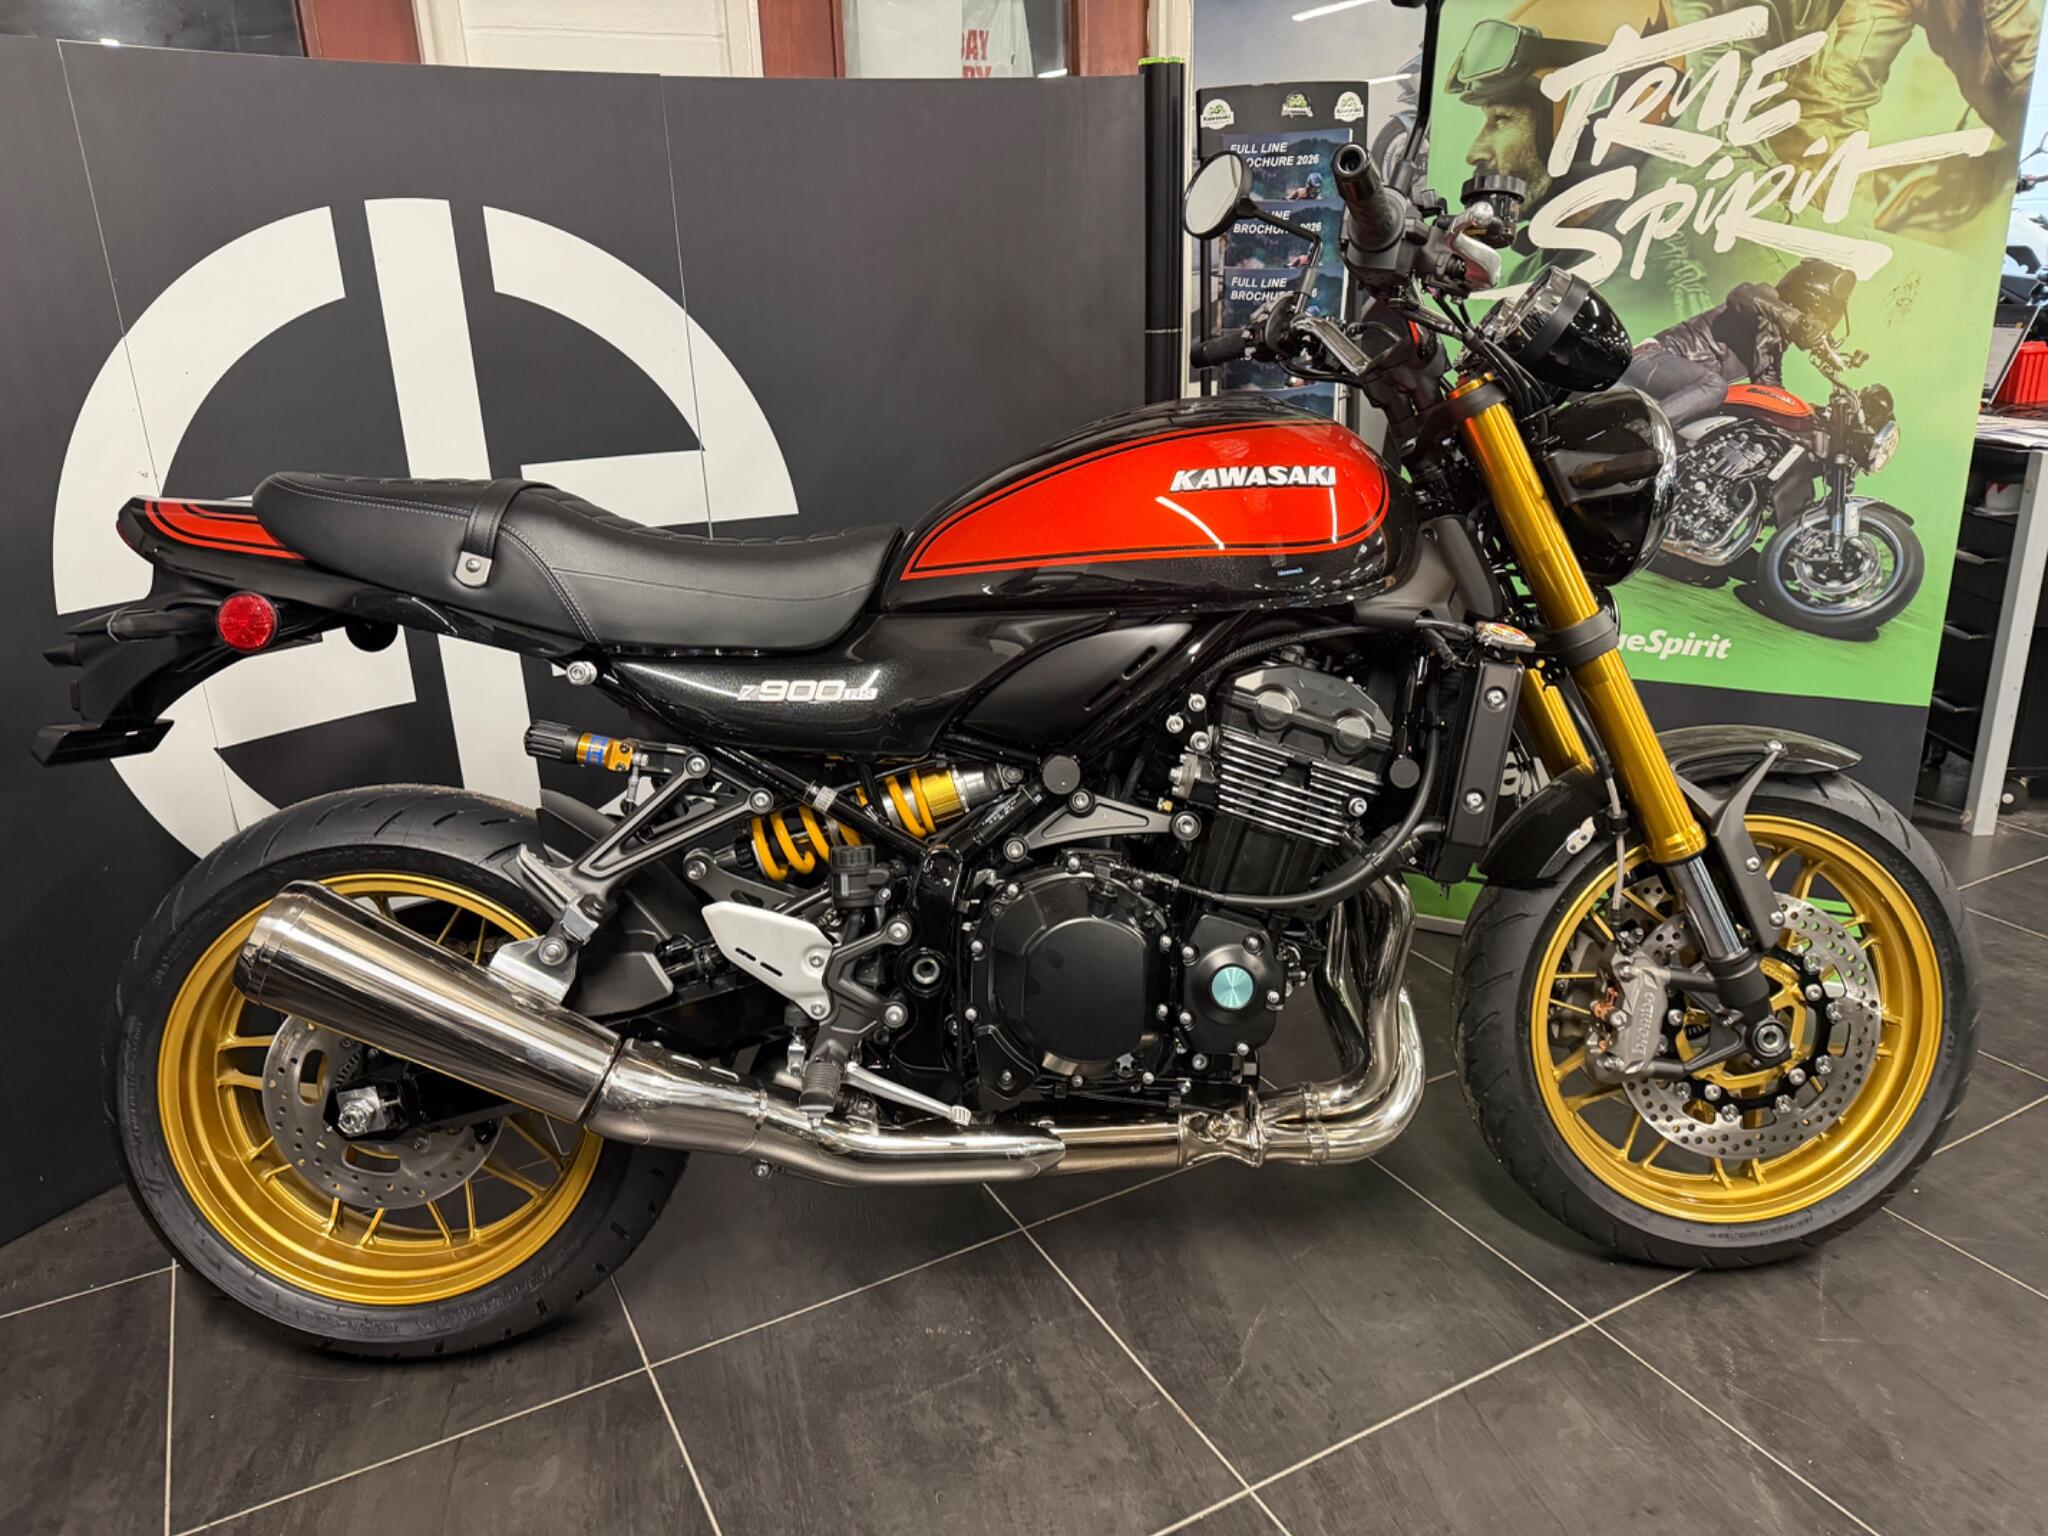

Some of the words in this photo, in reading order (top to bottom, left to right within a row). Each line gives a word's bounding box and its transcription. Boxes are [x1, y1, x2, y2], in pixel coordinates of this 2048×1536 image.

[961, 29, 989, 61] AY
[1230, 143, 1258, 154] FULL
[1260, 142, 1289, 153] LINE
[1245, 155, 1294, 168] OCHURE
[1296, 153, 1320, 166] 2026
[1233, 223, 1289, 235] BROCHU
[1231, 276, 1259, 288] FULL
[1260, 278, 1288, 288] LINE
[1169, 466, 1336, 493] KAWASAKI
[1632, 991, 1656, 1056] brembo
